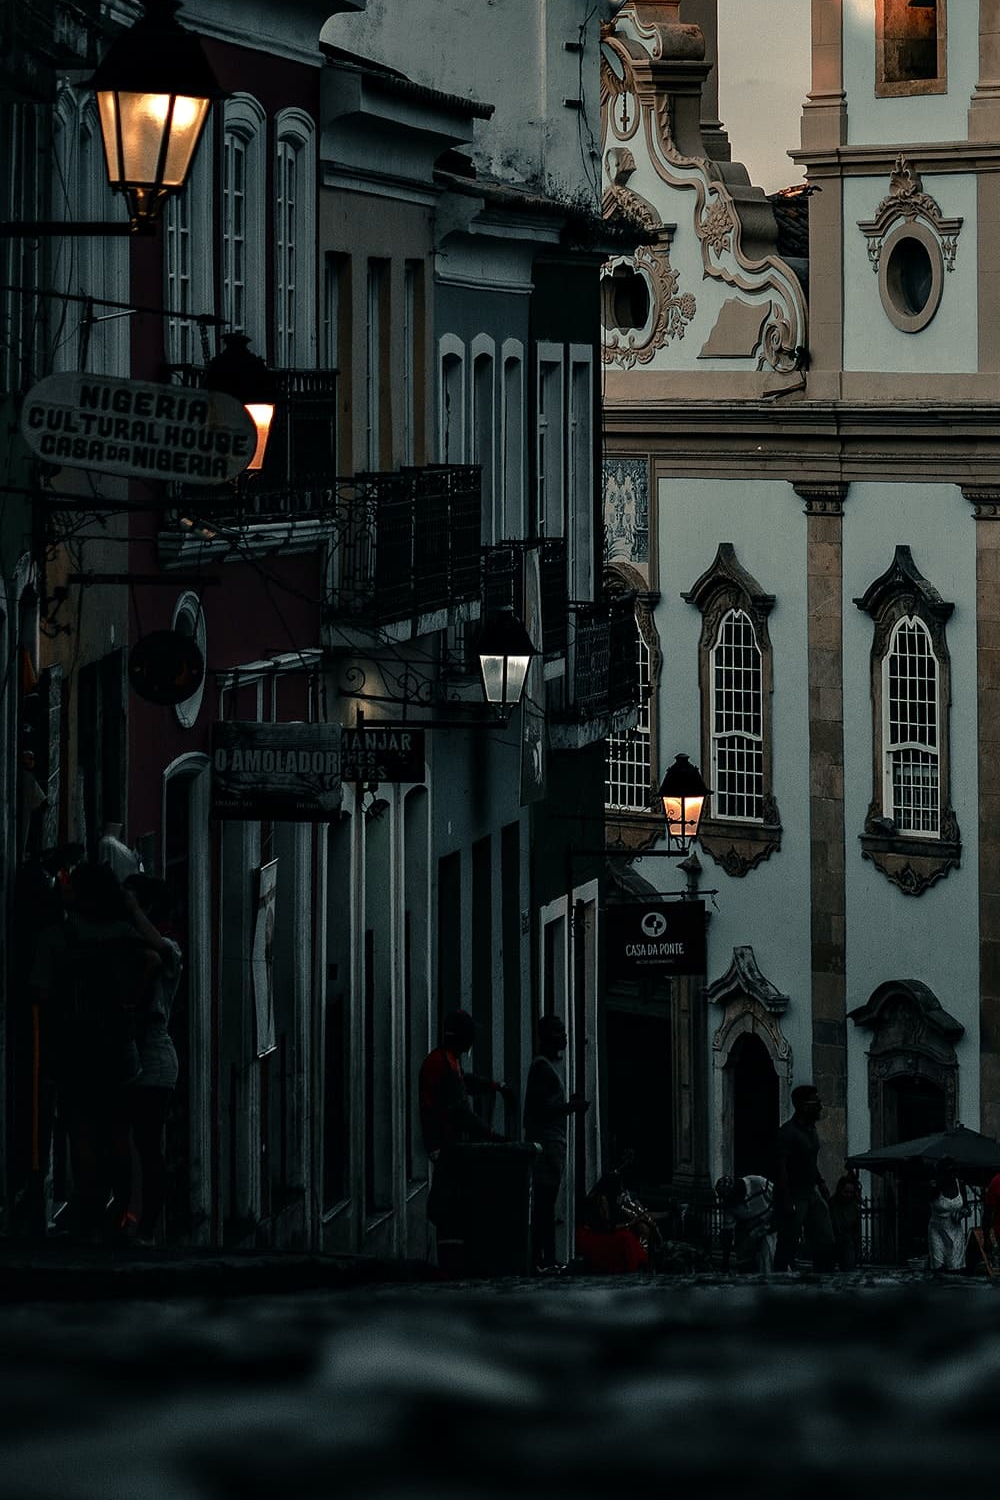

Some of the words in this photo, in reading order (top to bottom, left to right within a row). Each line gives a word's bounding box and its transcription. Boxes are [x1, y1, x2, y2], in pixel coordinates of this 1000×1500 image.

[80, 385, 208, 424] NIGERIA
[29, 406, 158, 444] CULTURAL
[164, 425, 248, 456] HOUSE
[40, 435, 104, 461] CASA
[107, 445, 130, 462] DA
[132, 446, 228, 478] NIGERIA
[214, 748, 227, 772] O
[231, 749, 338, 773] AMOLADOR
[625, 943, 646, 956] CASA
[647, 943, 658, 956] DA
[659, 942, 685, 955] PONTE
